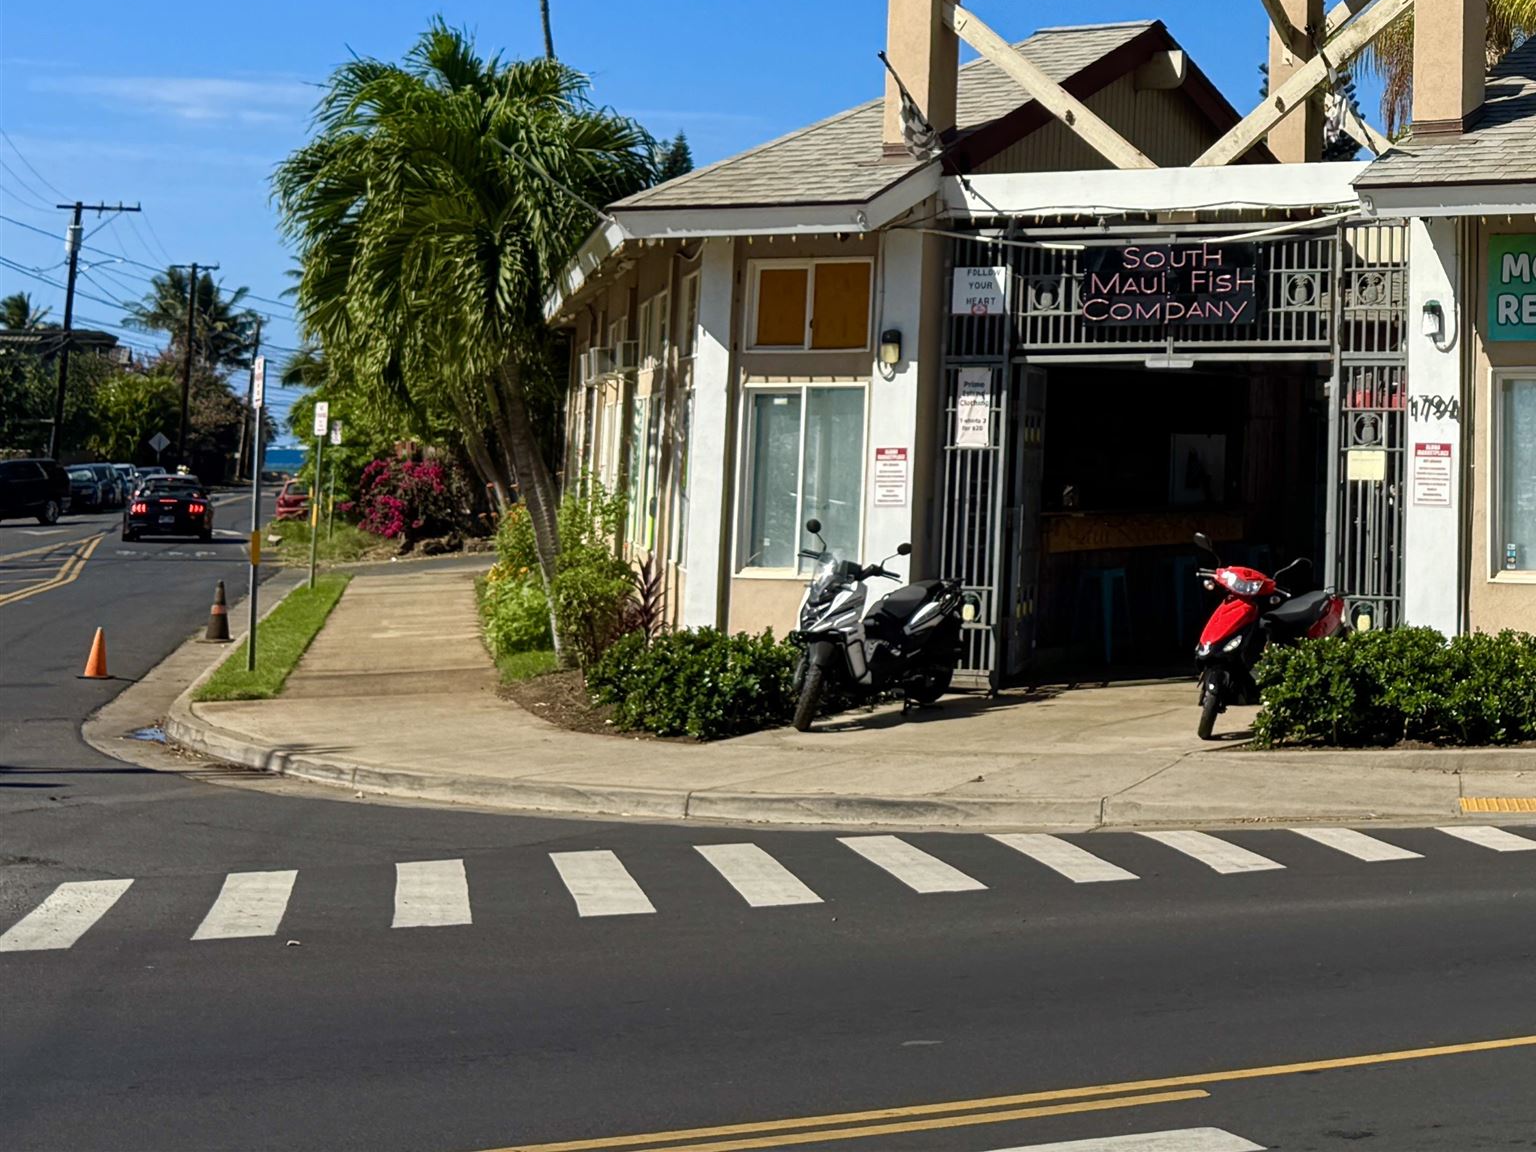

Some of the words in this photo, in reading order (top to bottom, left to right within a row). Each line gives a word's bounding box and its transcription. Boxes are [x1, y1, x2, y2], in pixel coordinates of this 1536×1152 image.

[967, 269, 1002, 277] FOLLOW
[966, 297, 997, 305] HEART
[1083, 298, 1248, 324] COMPANY
